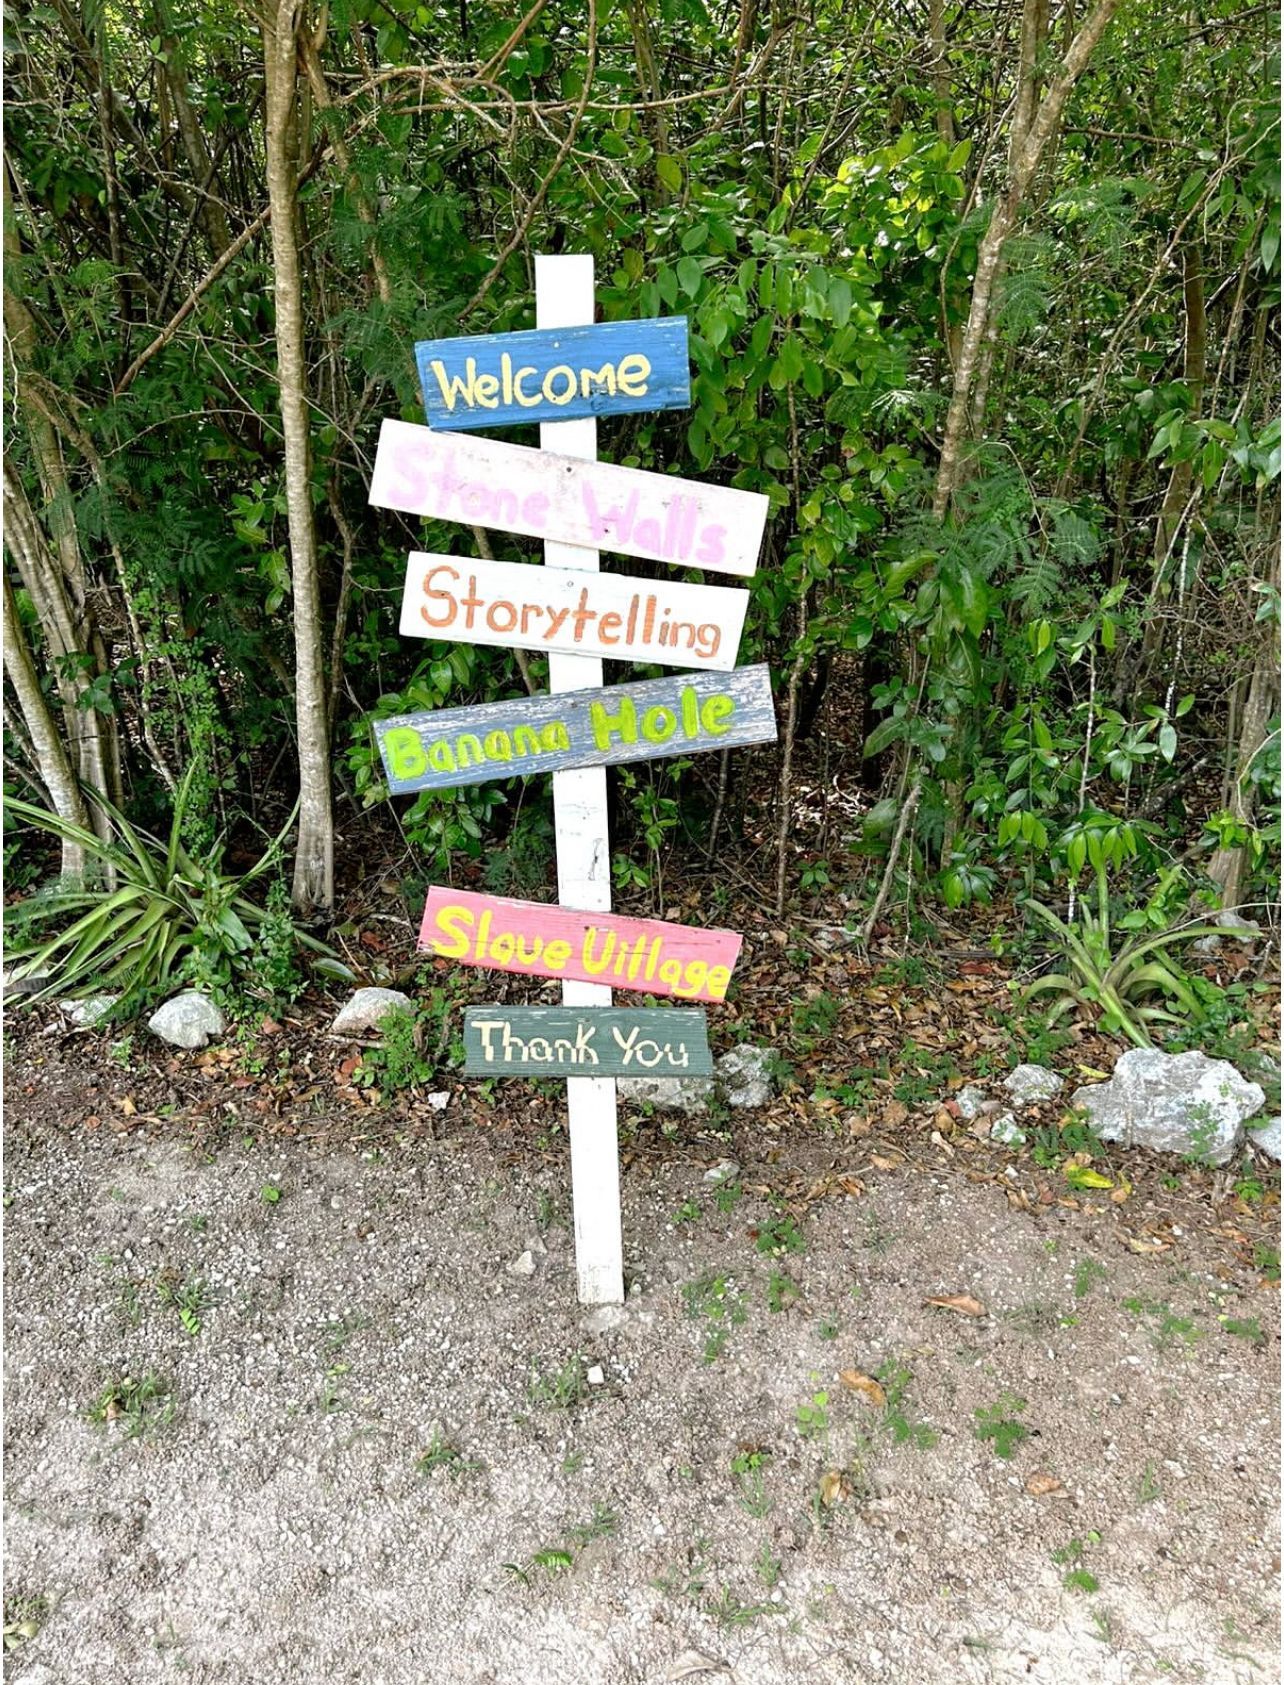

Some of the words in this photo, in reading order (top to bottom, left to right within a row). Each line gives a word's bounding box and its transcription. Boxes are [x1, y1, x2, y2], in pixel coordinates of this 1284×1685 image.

[430, 352, 652, 411] Welcome
[386, 439, 551, 528] Stone
[581, 479, 729, 564] Walls
[420, 564, 723, 659] Storytelling
[381, 725, 571, 781] Banana
[589, 684, 736, 751] Hole
[612, 1026, 690, 1068] You
